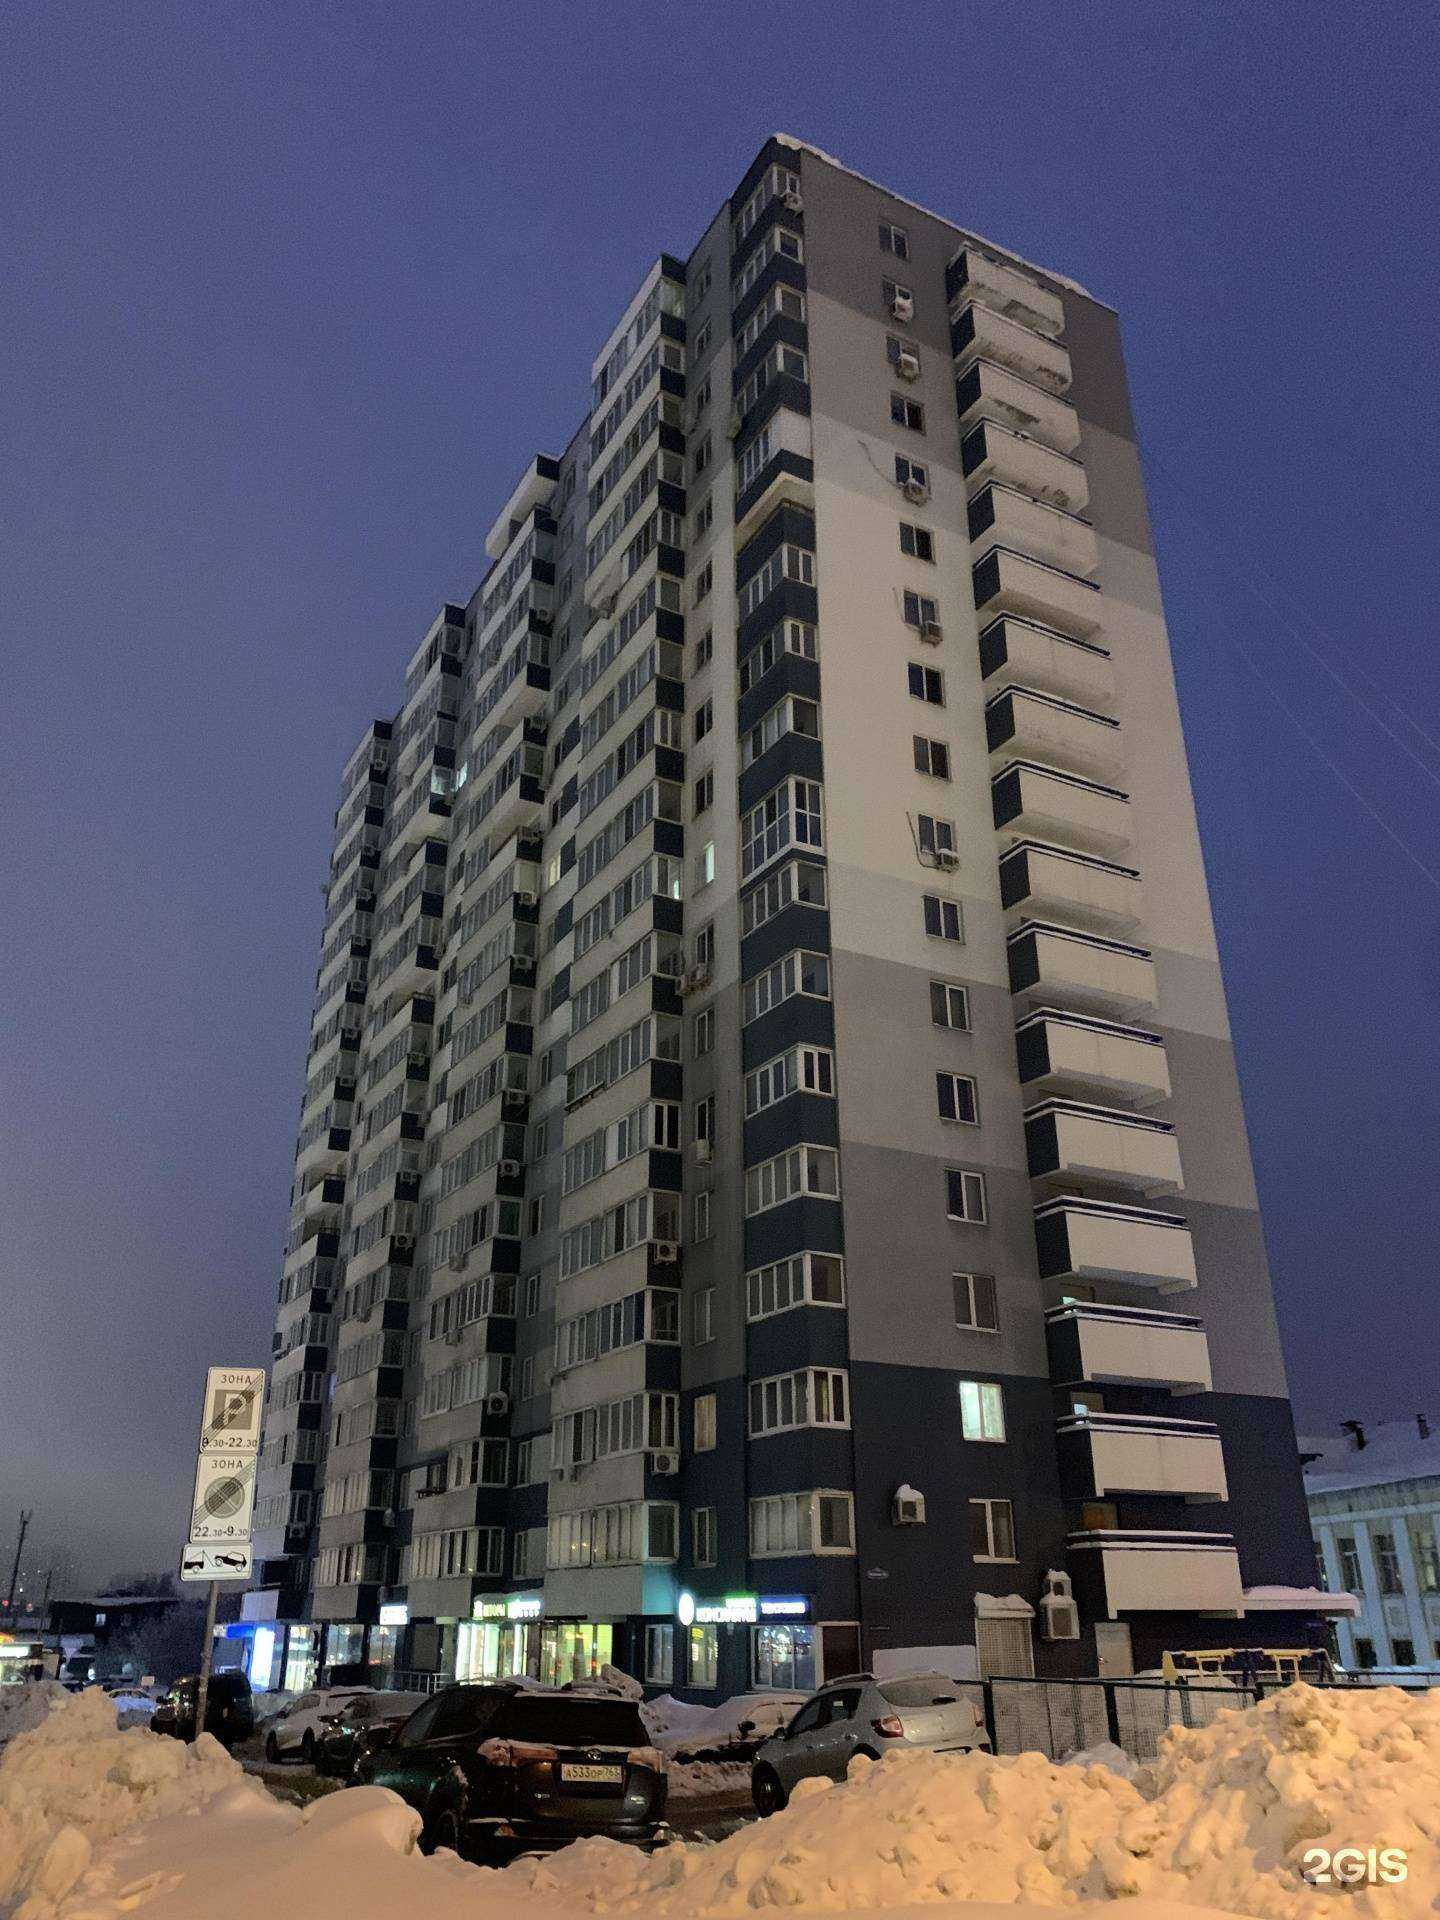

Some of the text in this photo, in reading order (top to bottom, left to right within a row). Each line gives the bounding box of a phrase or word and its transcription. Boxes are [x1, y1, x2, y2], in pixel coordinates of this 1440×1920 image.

[220, 1374, 252, 1385] ЗОНА
[211, 1459, 244, 1469] ЗОНА
[194, 1526, 248, 1537] 22.30-9.30
